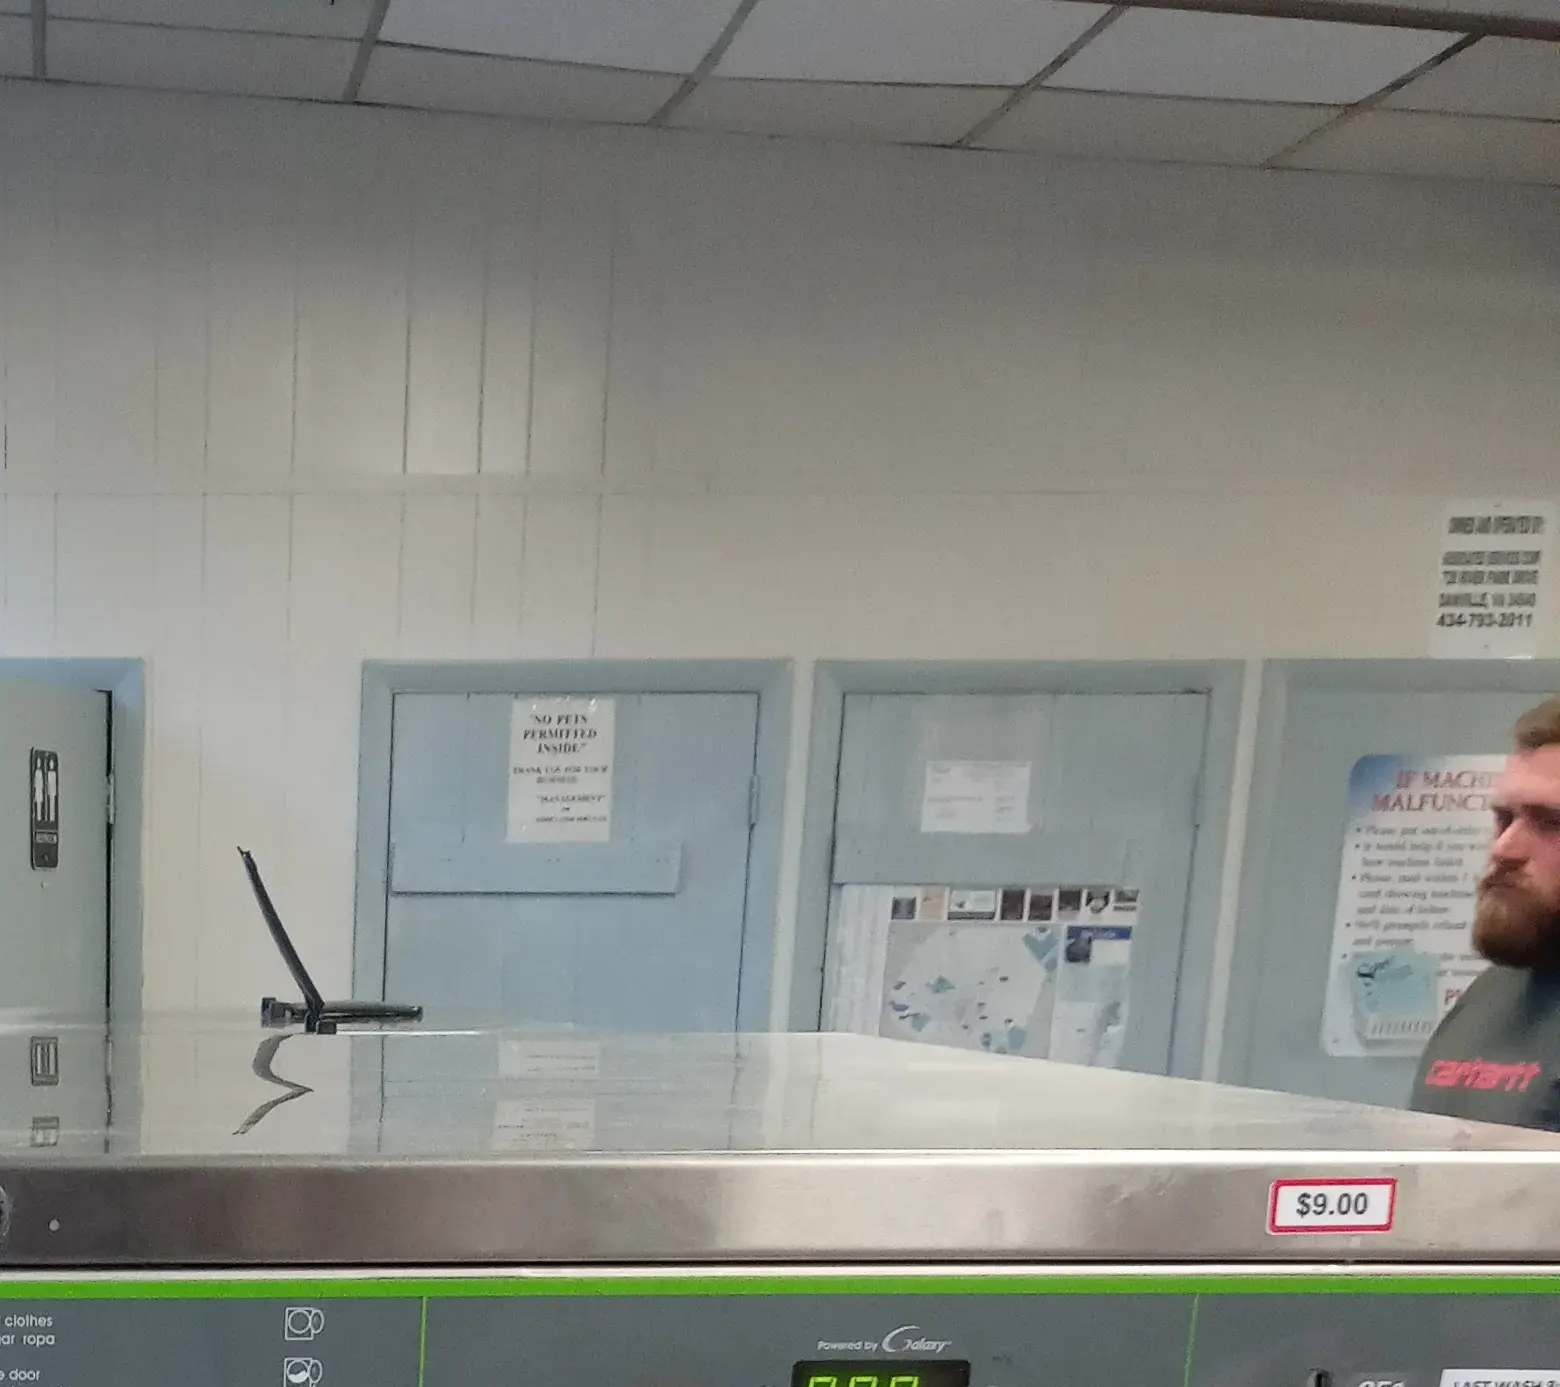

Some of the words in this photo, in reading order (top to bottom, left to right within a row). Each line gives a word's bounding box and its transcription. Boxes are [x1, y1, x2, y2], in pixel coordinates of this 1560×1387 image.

[556, 713, 588, 725] PETS
[523, 728, 597, 740] PERMITTED
[1296, 1192, 1368, 1218] $9.00
[5, 1314, 53, 1327] clothes
[23, 1334, 56, 1348] ropa
[817, 1340, 862, 1351] Powered
[864, 1340, 879, 1352] by
[881, 1325, 947, 1353] Galaxy
[9, 1368, 40, 1381] door
